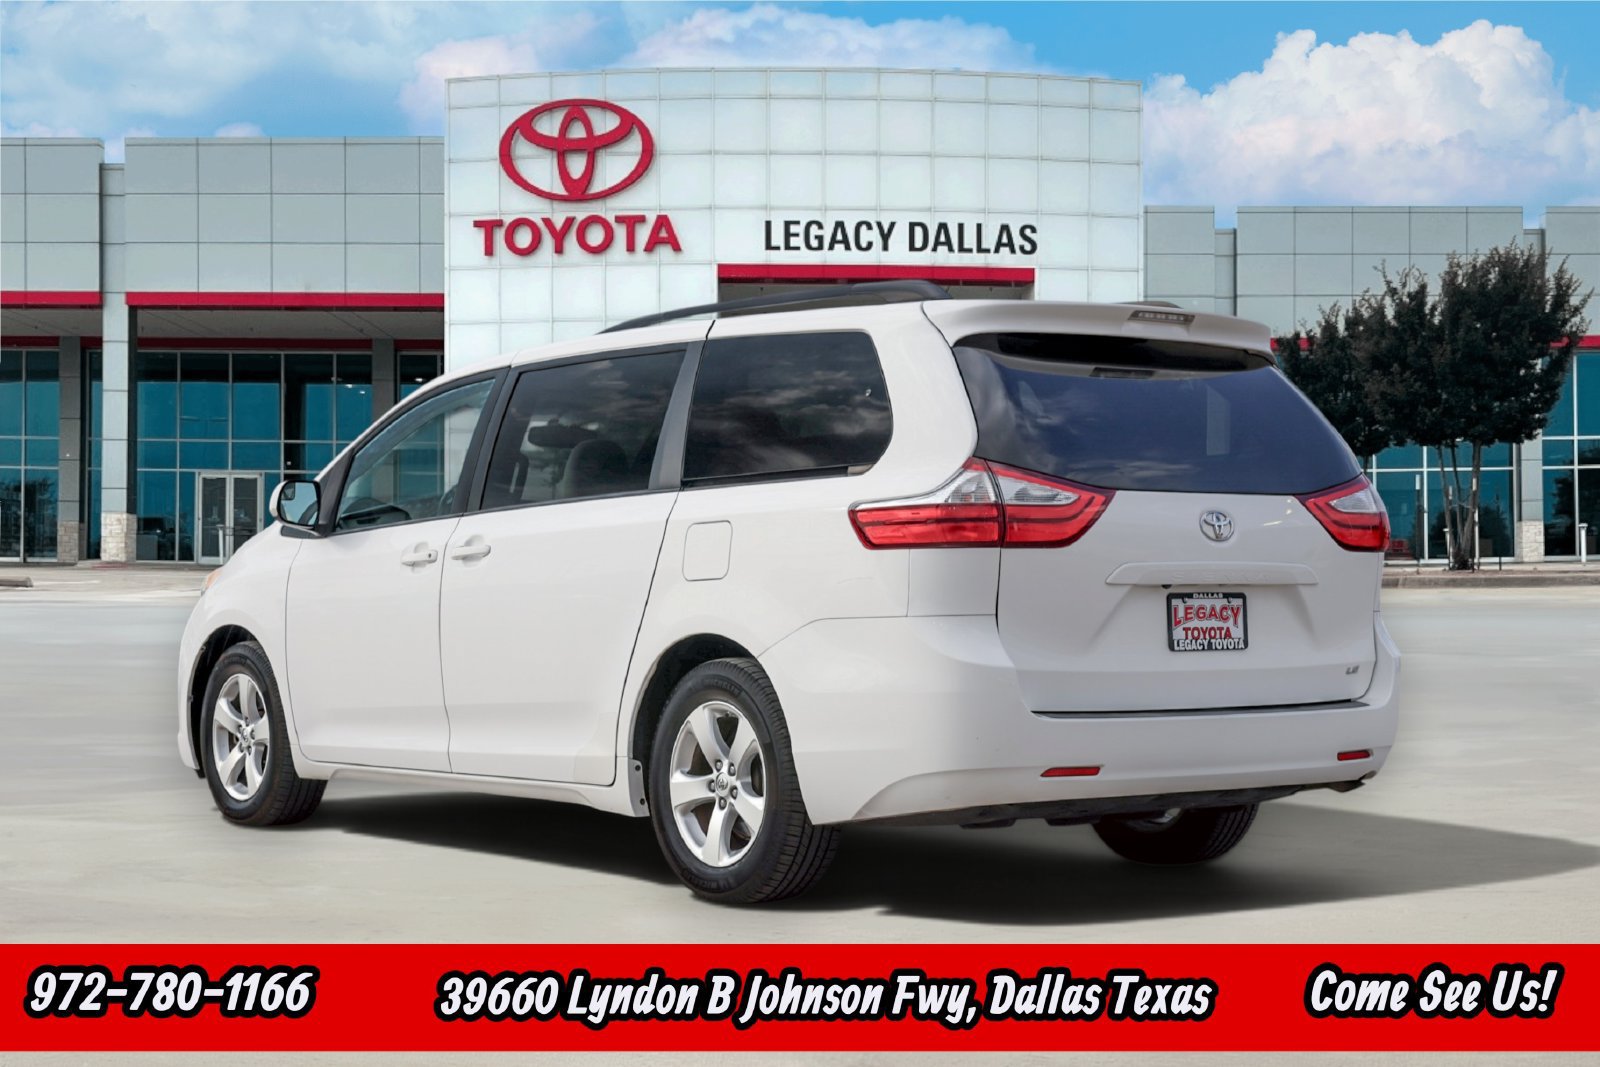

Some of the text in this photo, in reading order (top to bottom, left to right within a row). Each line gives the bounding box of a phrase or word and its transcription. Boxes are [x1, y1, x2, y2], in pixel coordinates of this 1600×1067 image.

[474, 214, 682, 257] TOYOTA
[764, 220, 1038, 256] LEGACY DALLAS
[1172, 604, 1243, 629] LEGACY
[1173, 638, 1245, 651] LEGACY TOYOTA
[1182, 626, 1233, 640] TOYOTA
